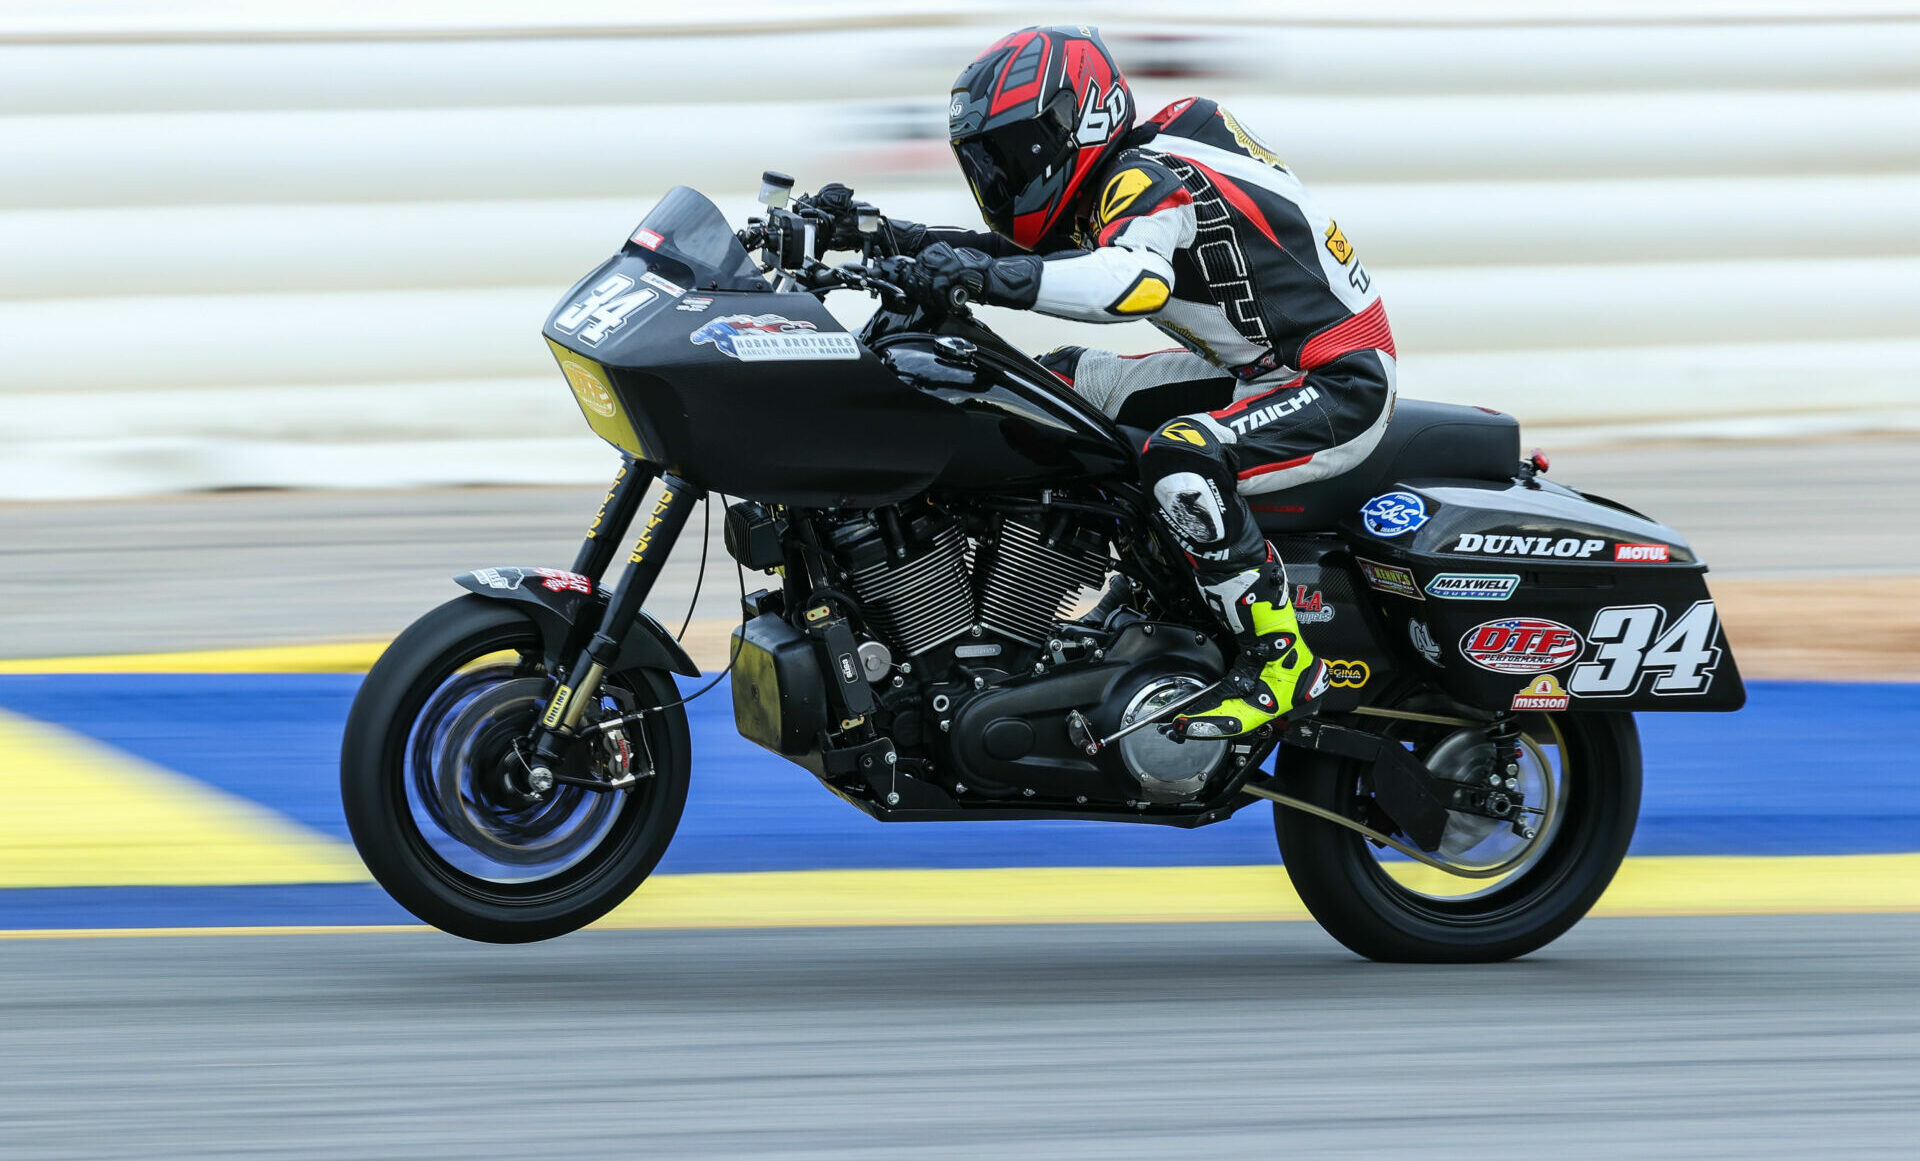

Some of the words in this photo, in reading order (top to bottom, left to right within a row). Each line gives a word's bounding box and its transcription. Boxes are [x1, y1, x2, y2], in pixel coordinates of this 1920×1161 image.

[554, 273, 659, 348] 34
[783, 337, 852, 347] BROTHERS
[1230, 386, 1320, 435] TAICHI
[1158, 507, 1190, 538] TAICHI
[1368, 500, 1420, 526] S&S
[1454, 533, 1605, 558] DUNLOP
[1616, 546, 1666, 561] MOTUL
[1437, 579, 1510, 590] MAXWELL
[1295, 585, 1322, 611] LA
[1465, 627, 1573, 654] DTF
[1567, 600, 1722, 698] 34
[1484, 654, 1559, 664] PERFORMANCE
[1328, 668, 1361, 676] EGINA
[1514, 698, 1566, 709] mission
